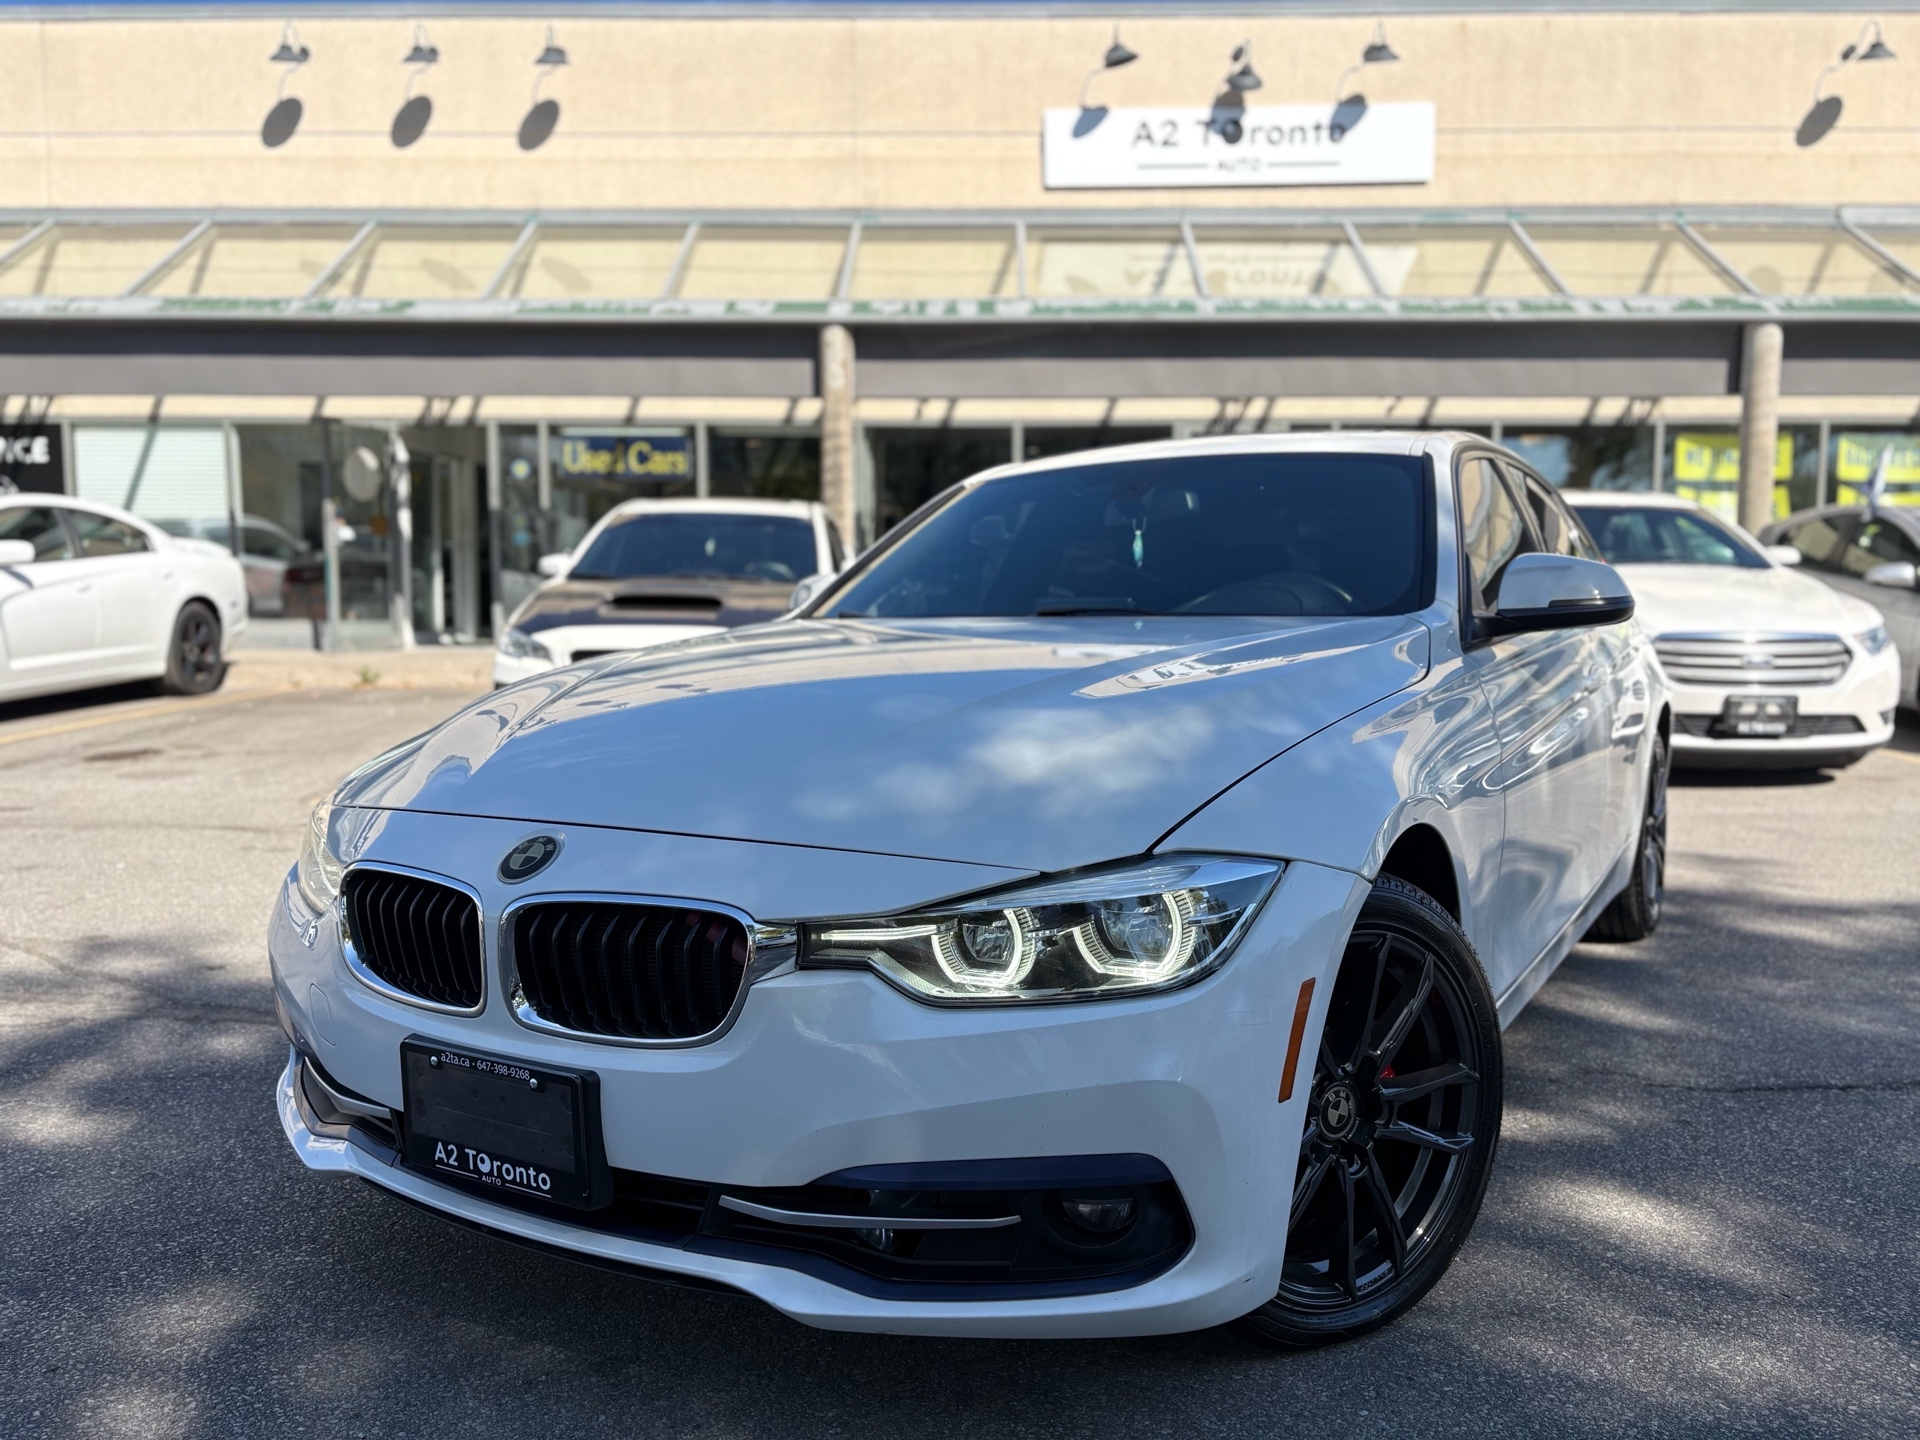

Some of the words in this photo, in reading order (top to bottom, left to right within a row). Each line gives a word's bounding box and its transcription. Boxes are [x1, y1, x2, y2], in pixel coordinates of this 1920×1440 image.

[1132, 121, 1178, 146] A2
[627, 440, 689, 475] Cars
[440, 1052, 470, 1067] a2ta.ca
[476, 1060, 530, 1080] 647-398-9268
[434, 1141, 459, 1167] A2
[481, 1174, 502, 1186] AUTO
